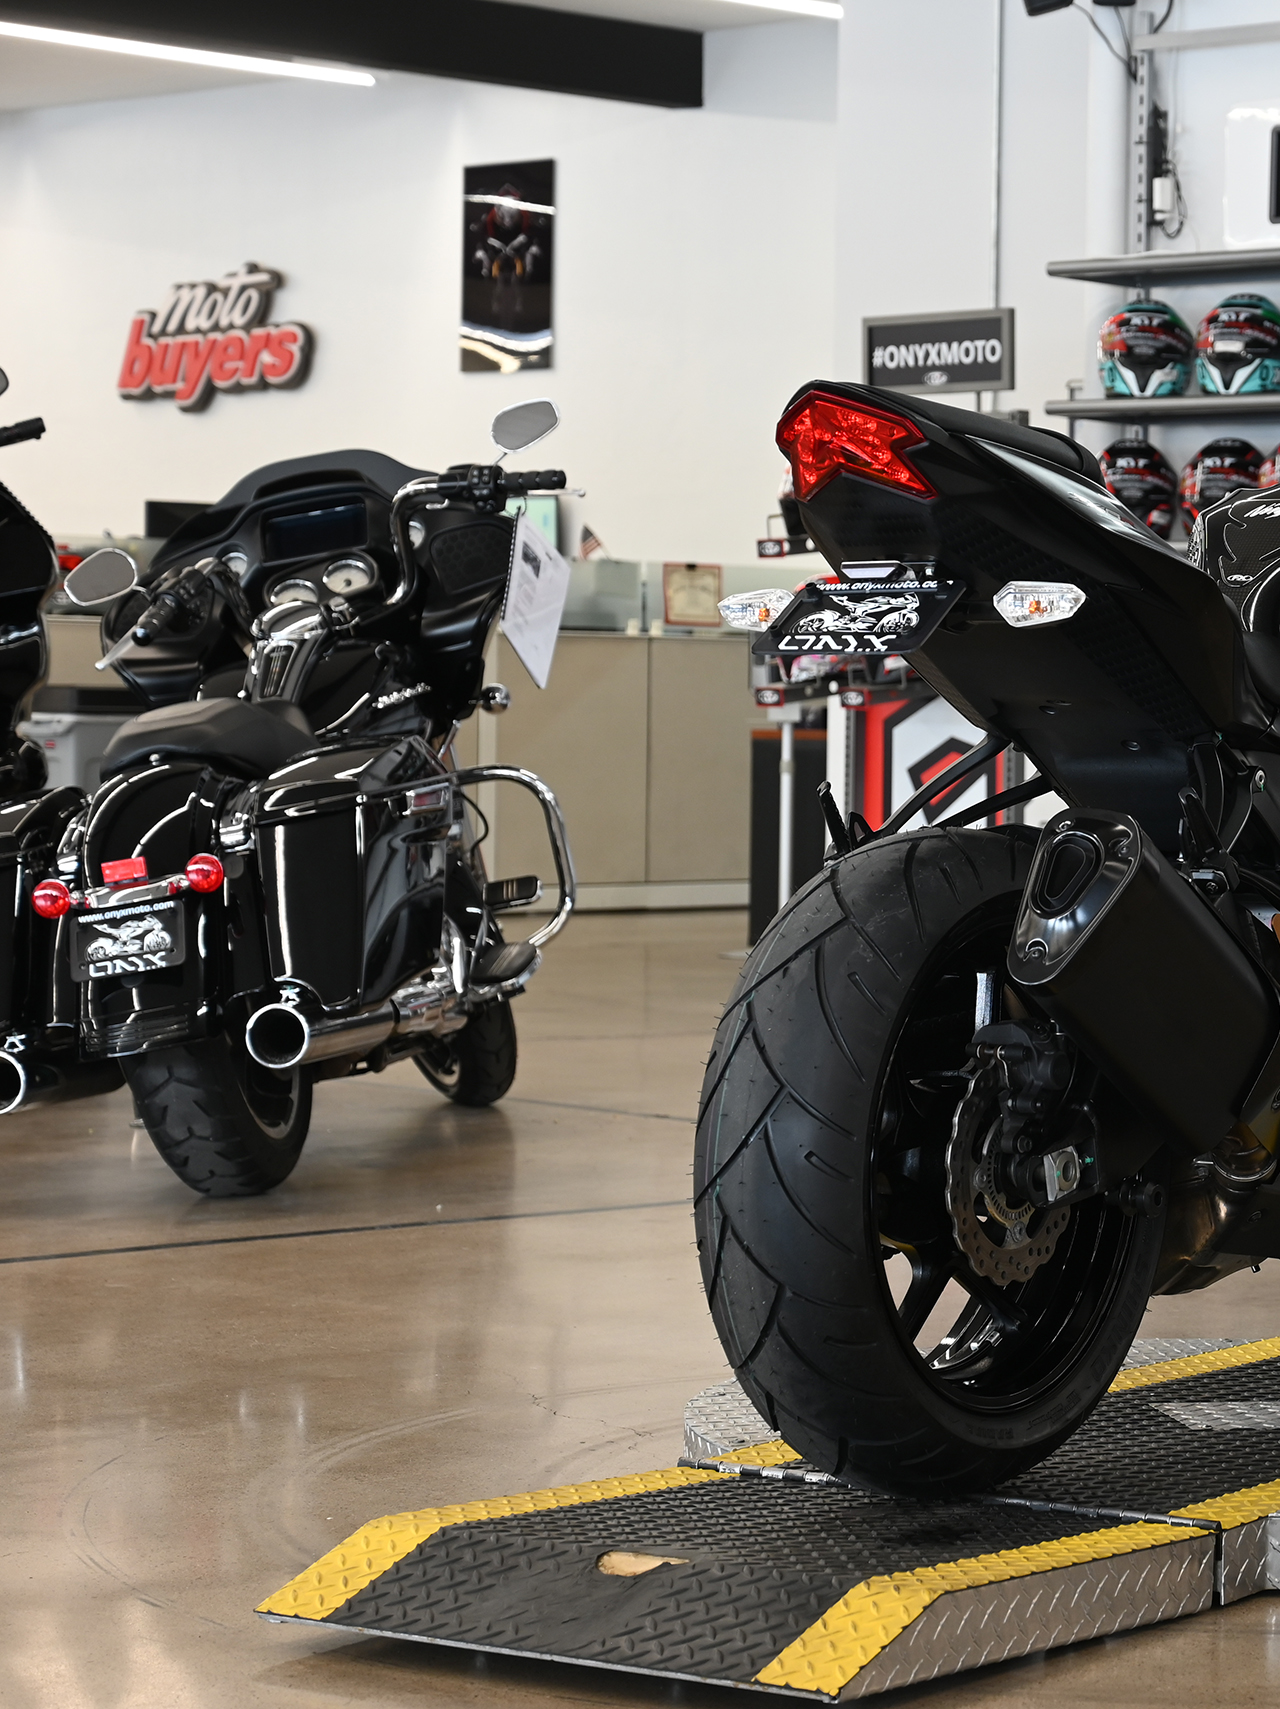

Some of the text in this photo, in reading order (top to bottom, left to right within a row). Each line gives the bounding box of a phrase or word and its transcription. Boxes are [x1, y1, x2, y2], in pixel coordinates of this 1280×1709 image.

[150, 265, 273, 335] Moto
[116, 312, 302, 407] buyers
[872, 338, 1002, 369] #ONYXMOTO
[78, 901, 175, 923] www.onyxmoto.com
